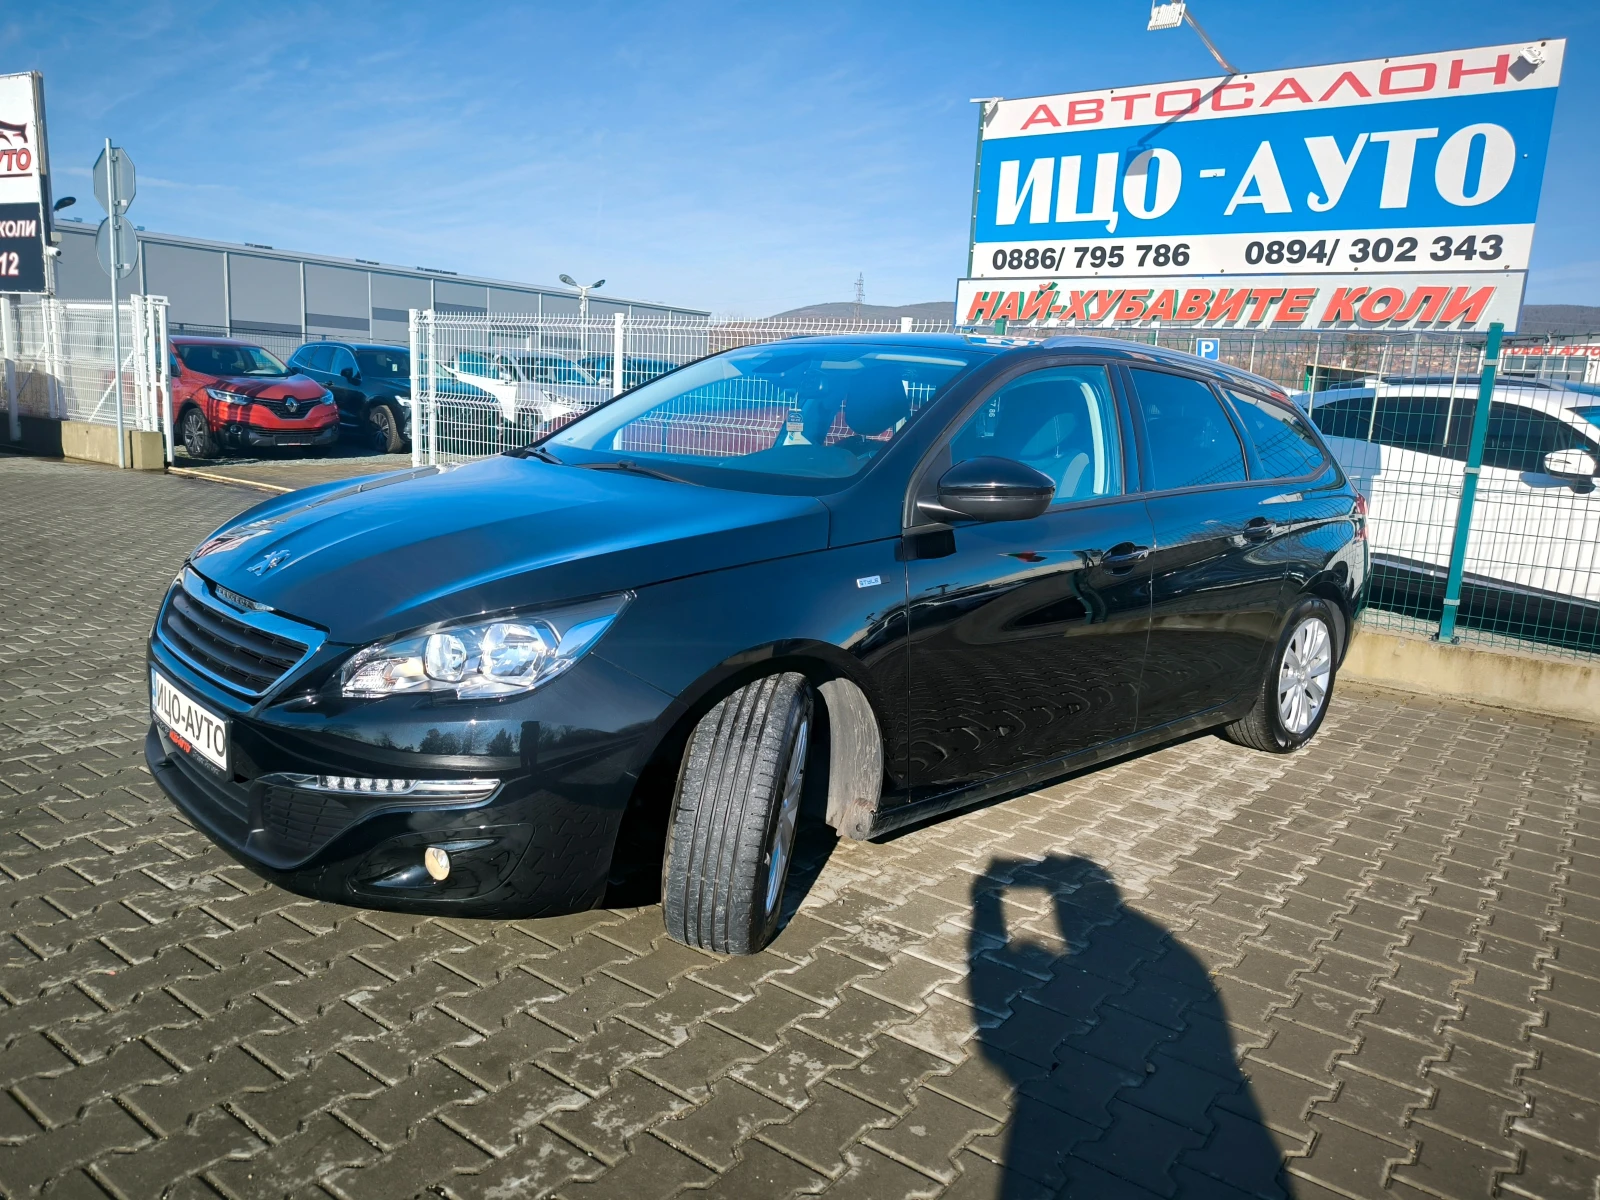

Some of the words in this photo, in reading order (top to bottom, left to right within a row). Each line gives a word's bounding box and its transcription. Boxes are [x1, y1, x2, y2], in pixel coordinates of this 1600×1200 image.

[1020, 53, 1511, 130] АВТОСАЛОН
[992, 248, 1066, 272] 0886/
[1073, 245, 1125, 268] 795
[1135, 243, 1191, 267] 786
[1244, 239, 1340, 266] 0894/
[1348, 237, 1418, 263] 302
[1429, 234, 1504, 261] 343
[966, 281, 1318, 322] НАЙ-ХУБАВИТЕ
[1322, 286, 1496, 323] КОЛИ
[1201, 341, 1214, 358] P
[157, 680, 226, 757] ИЦО-АУТО
